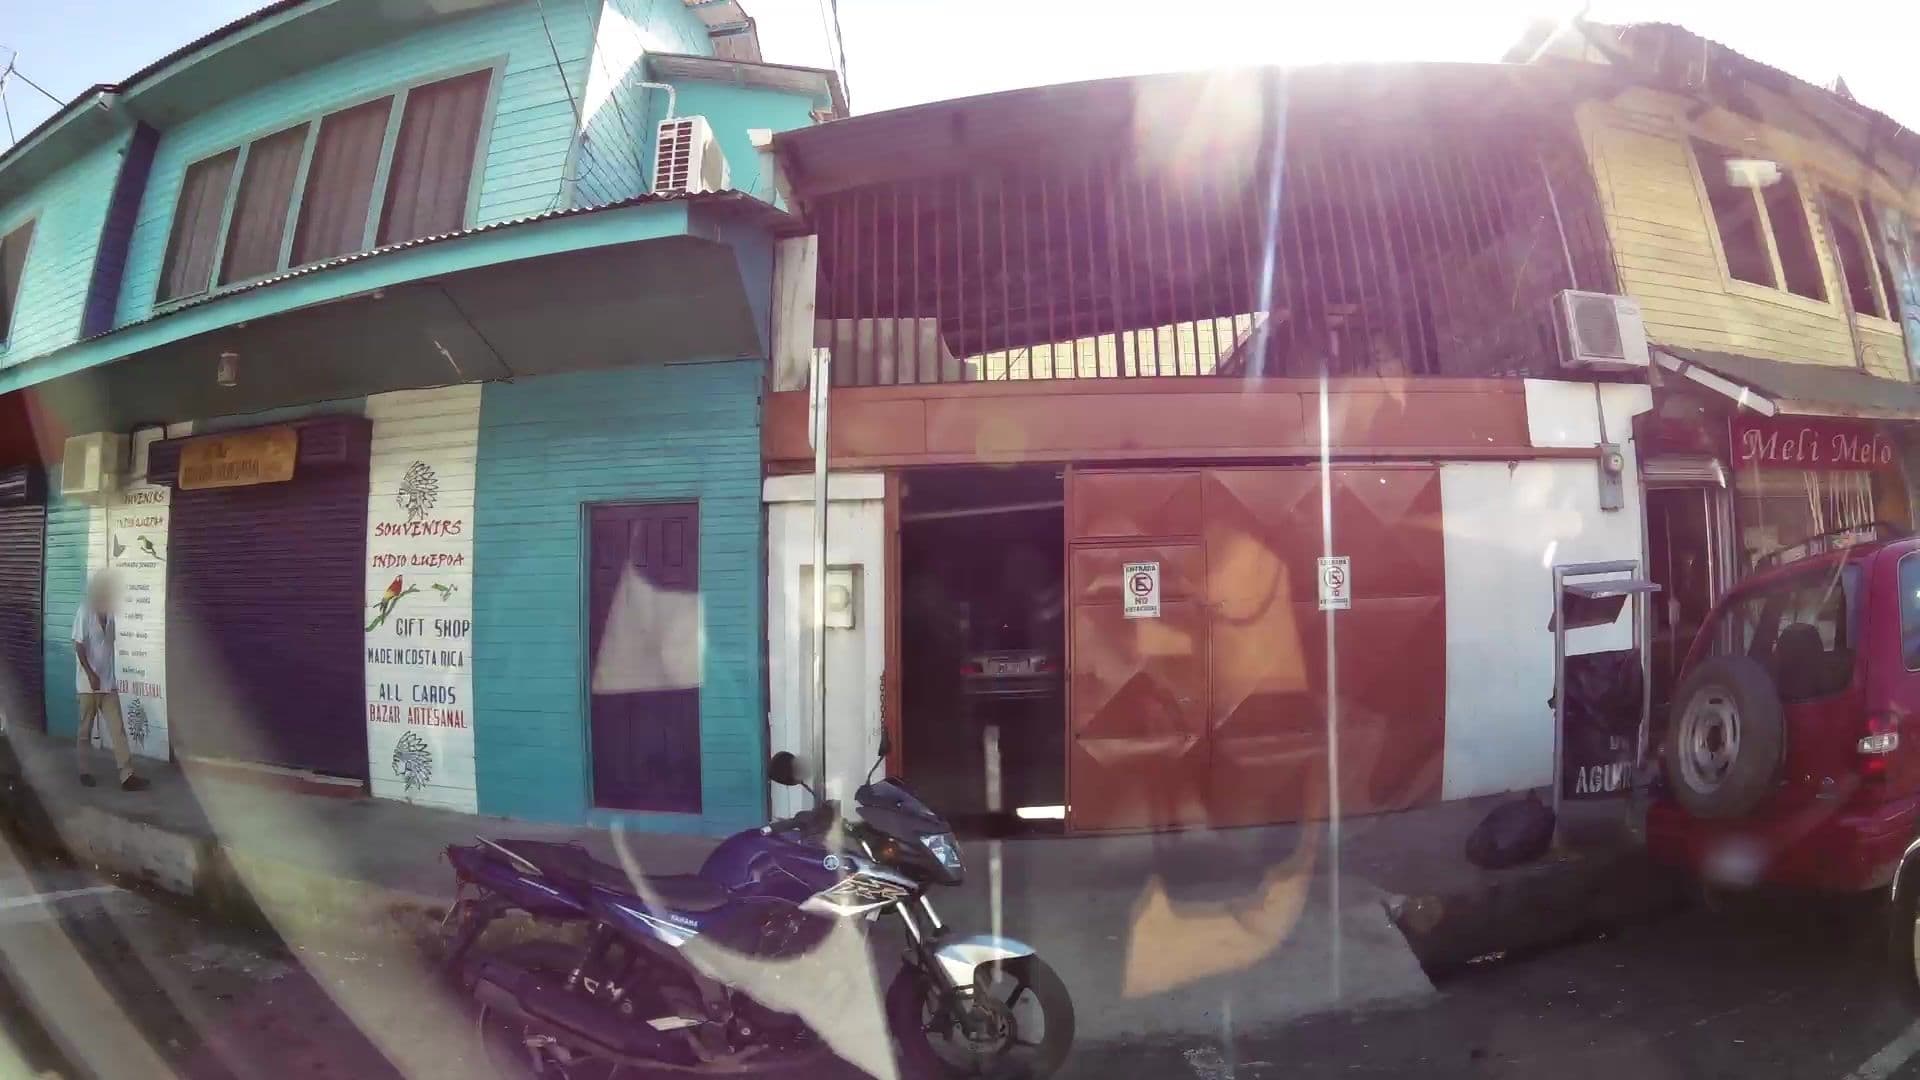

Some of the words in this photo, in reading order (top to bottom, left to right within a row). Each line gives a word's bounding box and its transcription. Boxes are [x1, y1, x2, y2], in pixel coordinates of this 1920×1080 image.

[1742, 428, 1820, 462] Meli
[1831, 433, 1892, 464] Melo
[374, 519, 462, 537] SOUVENIRS
[372, 553, 407, 569] INDIO
[395, 618, 425, 637] GIFT
[434, 619, 471, 639] SHOP
[367, 647, 393, 664] MADE
[393, 648, 404, 665] IN
[405, 648, 437, 666] COSTA
[440, 650, 464, 668] RICA
[379, 683, 403, 702] ALL
[412, 684, 457, 705] CARDS
[369, 704, 400, 723] BAZAR
[408, 706, 468, 729] ARTESANAL
